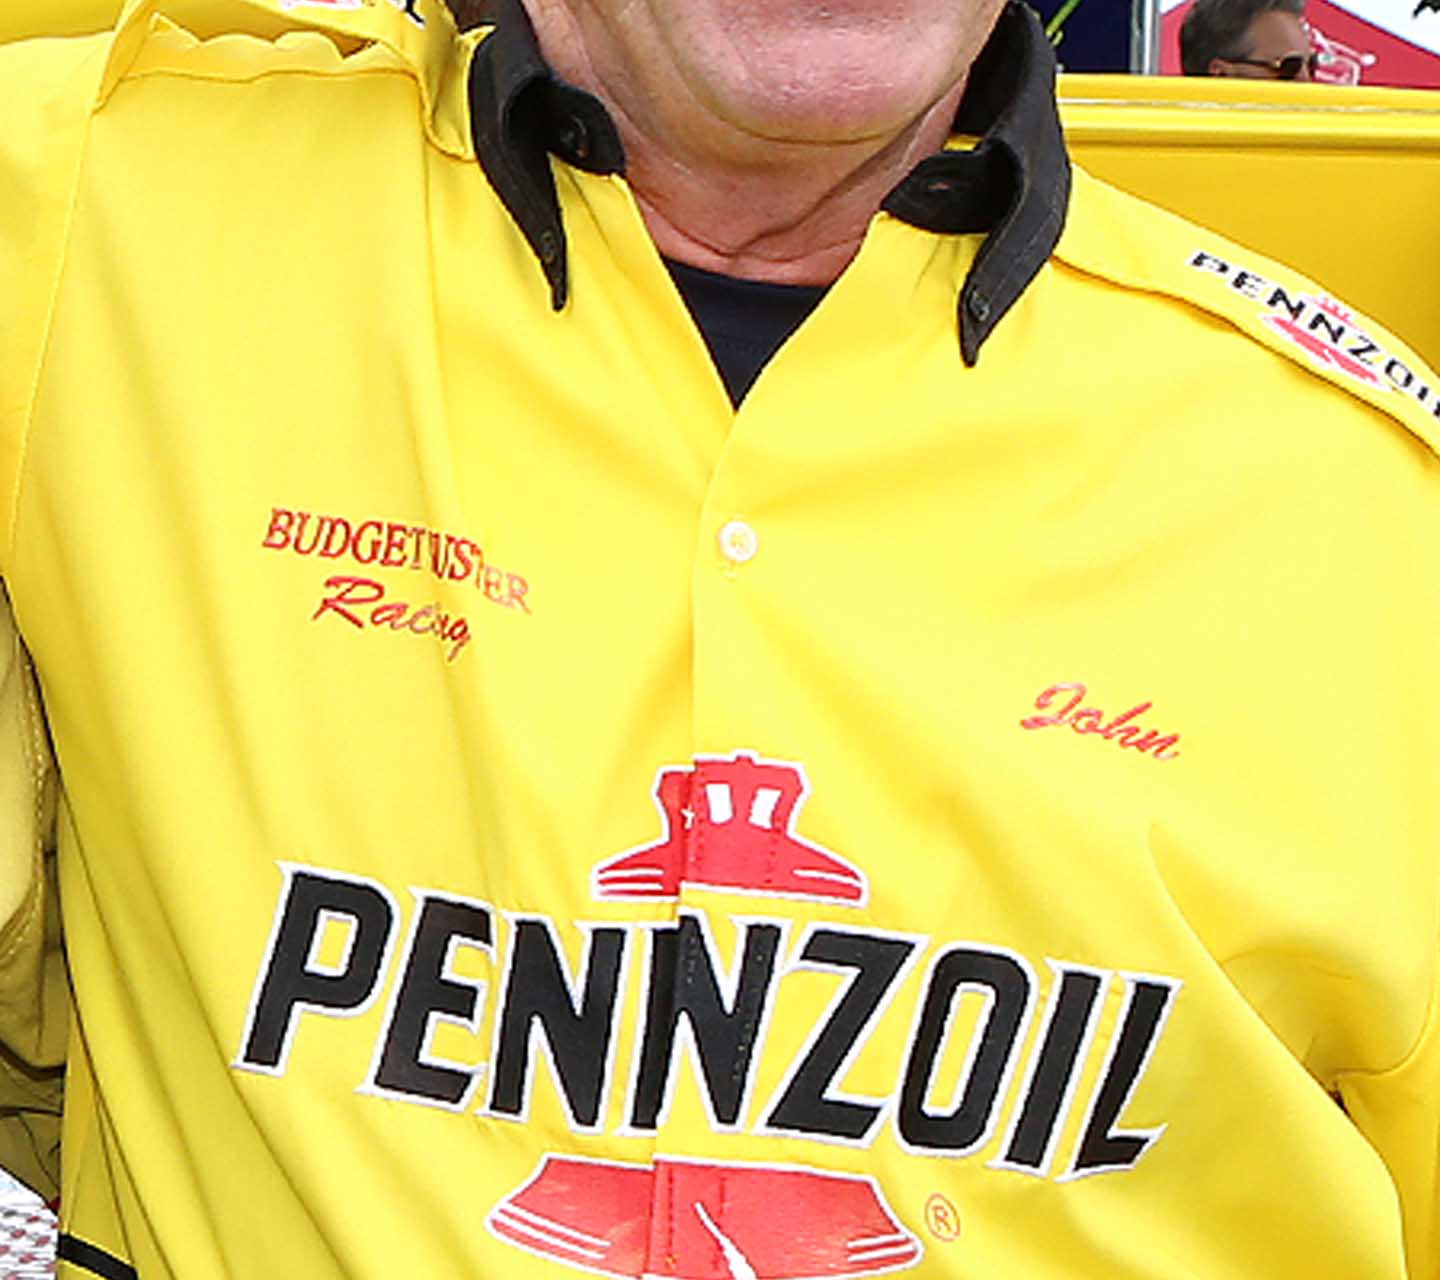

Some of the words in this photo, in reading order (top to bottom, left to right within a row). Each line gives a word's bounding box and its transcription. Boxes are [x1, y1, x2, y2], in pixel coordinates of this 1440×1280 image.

[262, 507, 532, 614] BUDGETUSTER
[313, 575, 471, 662] Racing
[1020, 682, 1180, 761] John
[230, 859, 1184, 1183] PENNZOIL
